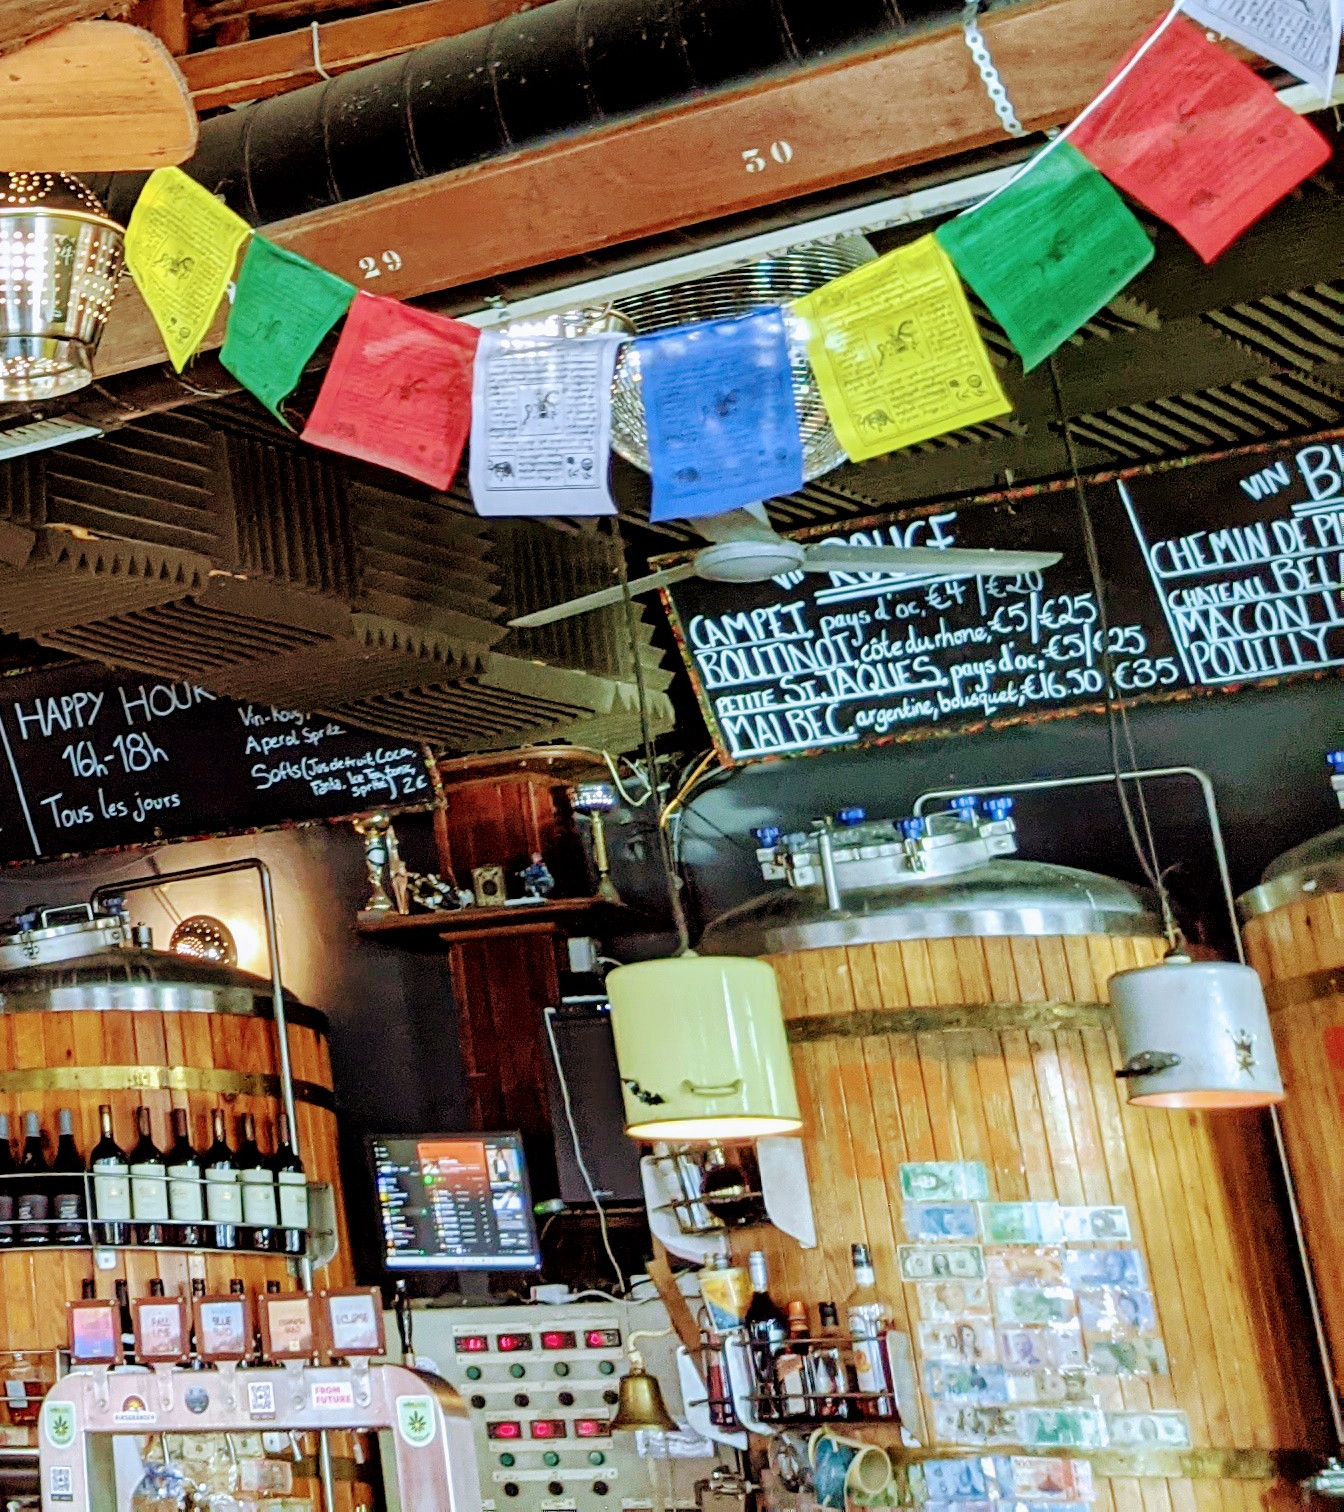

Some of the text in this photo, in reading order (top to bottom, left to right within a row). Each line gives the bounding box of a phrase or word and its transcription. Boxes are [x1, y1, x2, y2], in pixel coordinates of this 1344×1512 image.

[358, 249, 402, 280] 29
[1239, 461, 1291, 500] VIN
[1150, 523, 1272, 574] CHEMIN
[1272, 517, 1315, 555] DE
[1168, 576, 1272, 611] CHATEAU
[820, 609, 872, 648] pays
[1174, 595, 1312, 647] MACON
[1112, 656, 1180, 689] €35
[1189, 625, 1328, 681] POUILLY
[715, 687, 777, 714] PETITE
[950, 659, 996, 694] pays
[14, 691, 105, 740] HAPPY
[61, 732, 170, 780] 16h-18h
[244, 729, 300, 755] Aperol
[40, 787, 181, 829] Tous les jours
